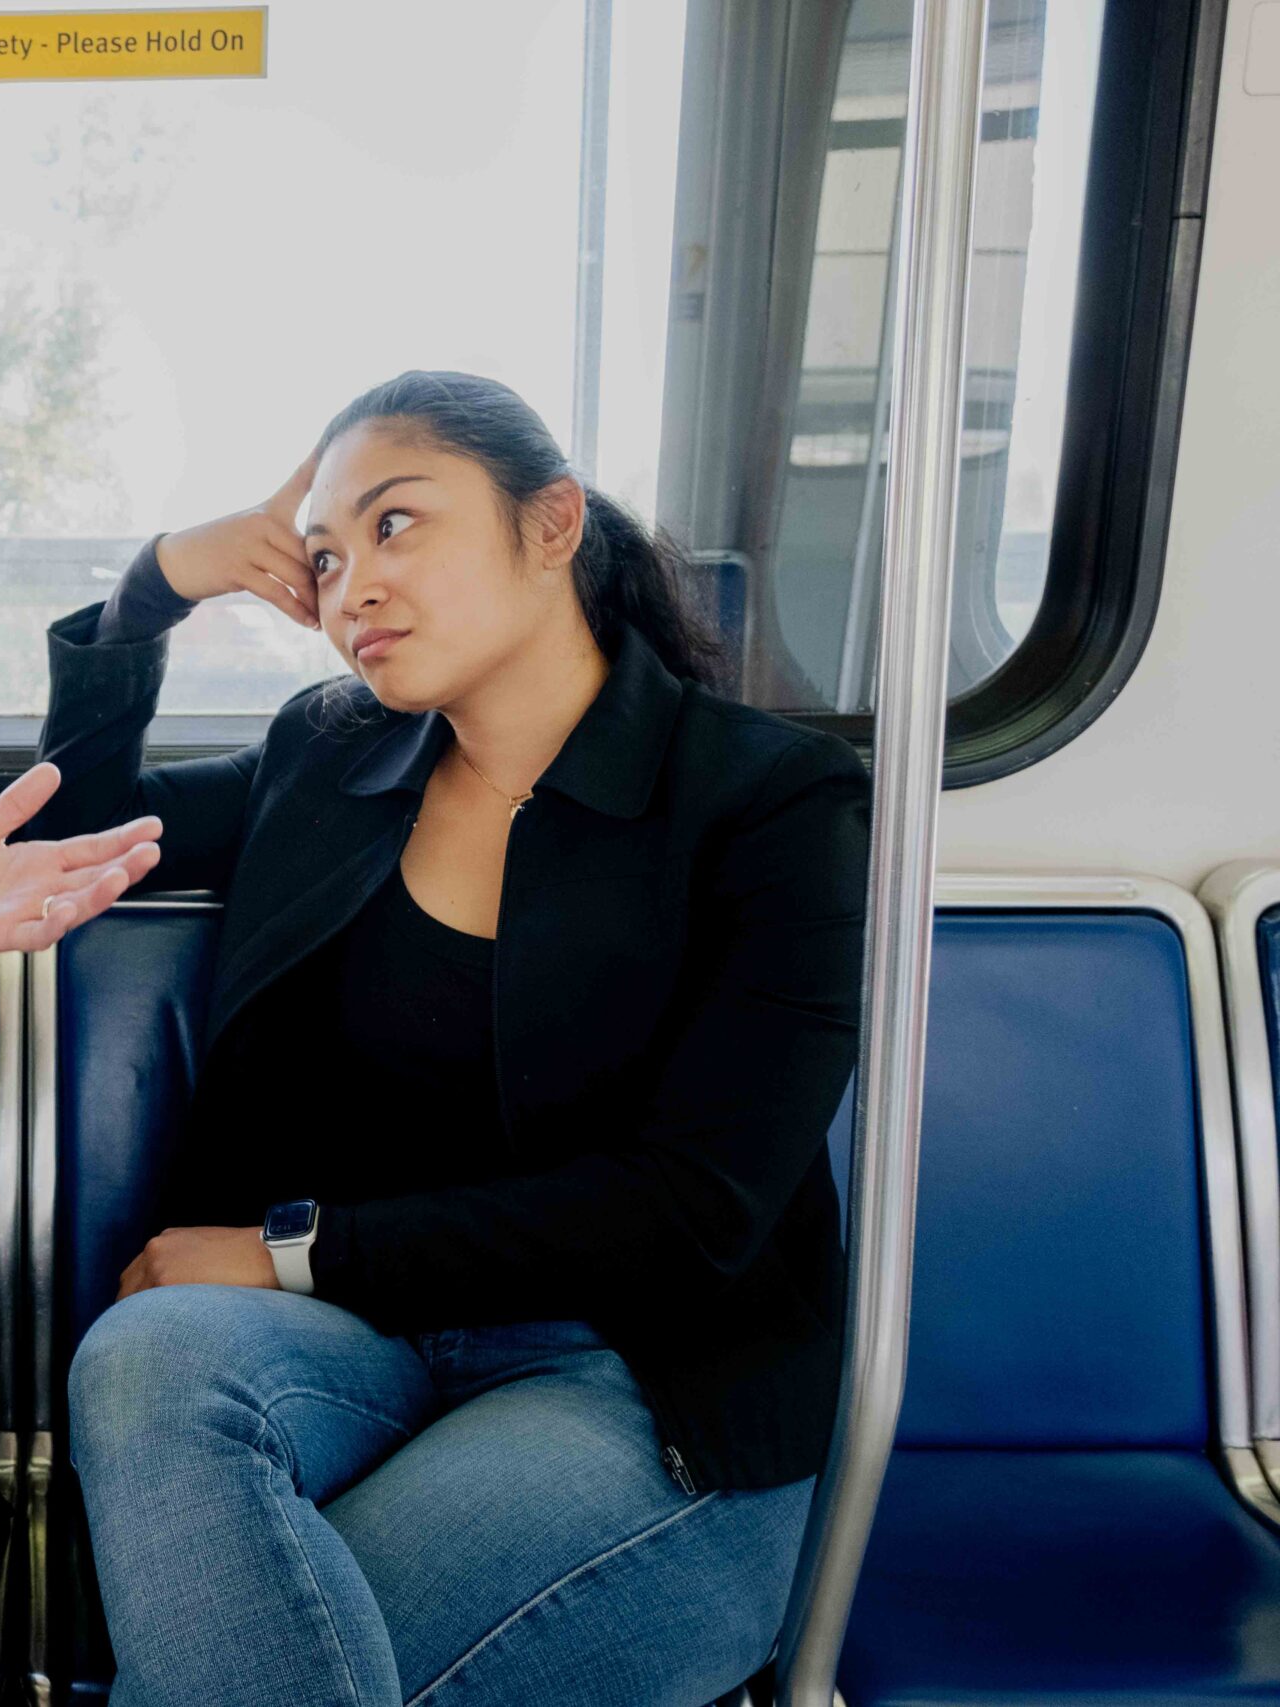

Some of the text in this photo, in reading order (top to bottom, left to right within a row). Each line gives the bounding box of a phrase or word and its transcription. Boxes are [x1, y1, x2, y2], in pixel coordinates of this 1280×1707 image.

[57, 31, 138, 54] Please
[146, 29, 201, 53] Hold
[210, 30, 244, 52] On
